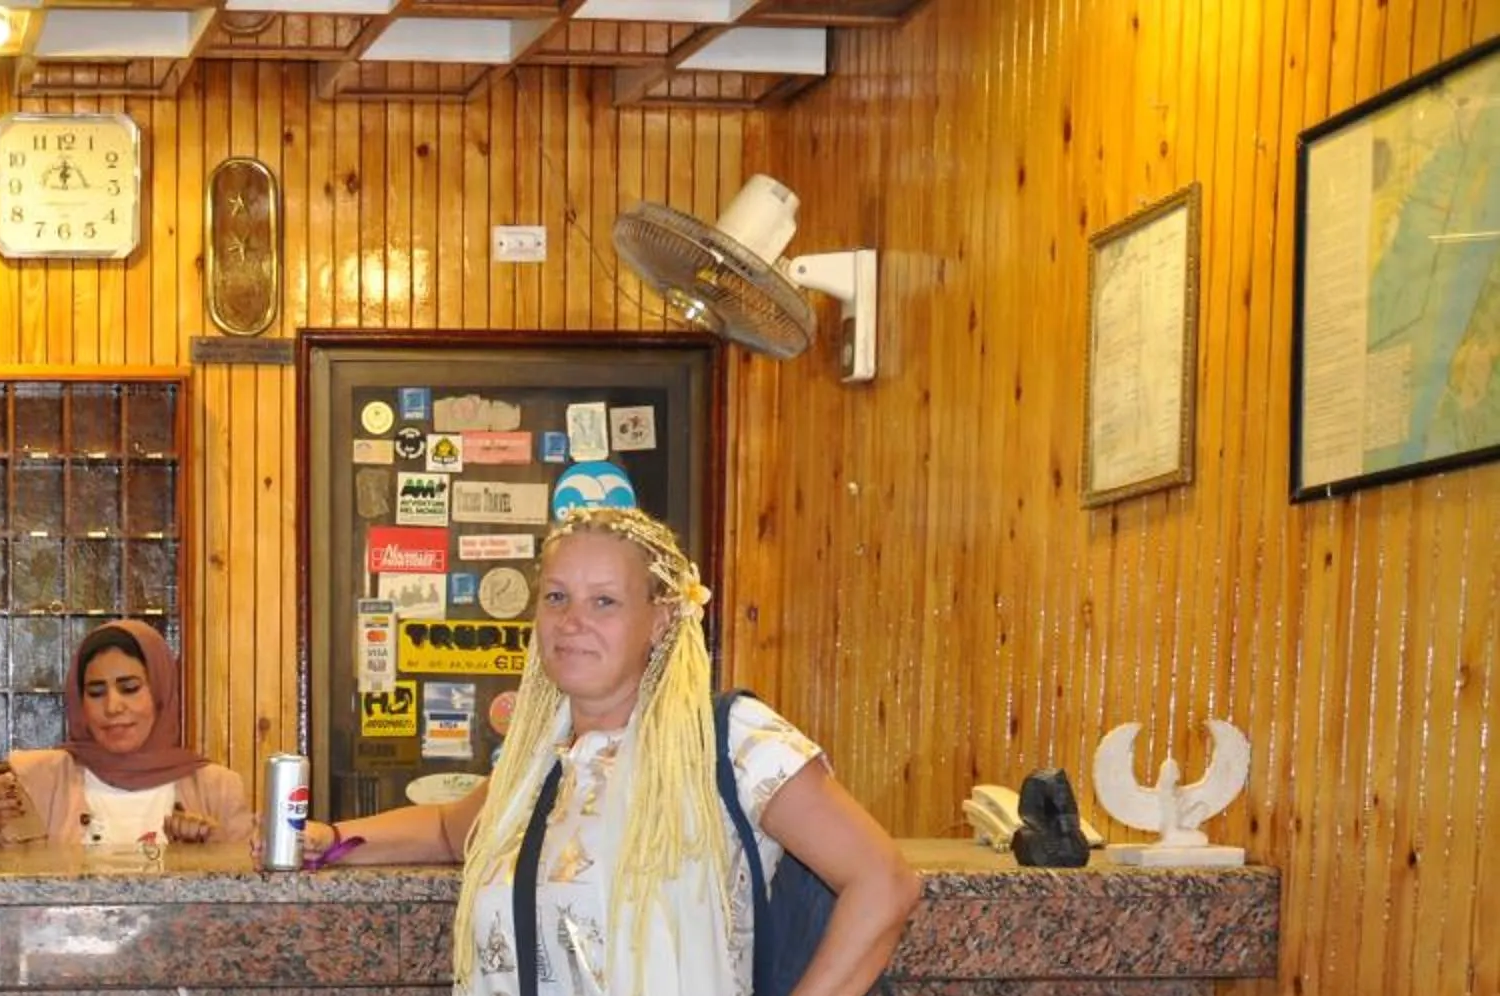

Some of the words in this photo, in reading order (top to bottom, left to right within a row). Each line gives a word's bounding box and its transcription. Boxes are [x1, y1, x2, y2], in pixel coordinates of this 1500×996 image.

[32, 135, 47, 151] 11
[56, 132, 76, 151] 12
[88, 135, 94, 151] 1
[9, 151, 27, 168] 10
[104, 151, 119, 169] 2
[8, 178, 23, 195] 9
[107, 179, 121, 196] 3
[10, 206, 24, 223] 8
[102, 208, 117, 225] 4
[34, 221, 47, 238] 7
[57, 222, 72, 240] 6
[83, 221, 97, 239] 5
